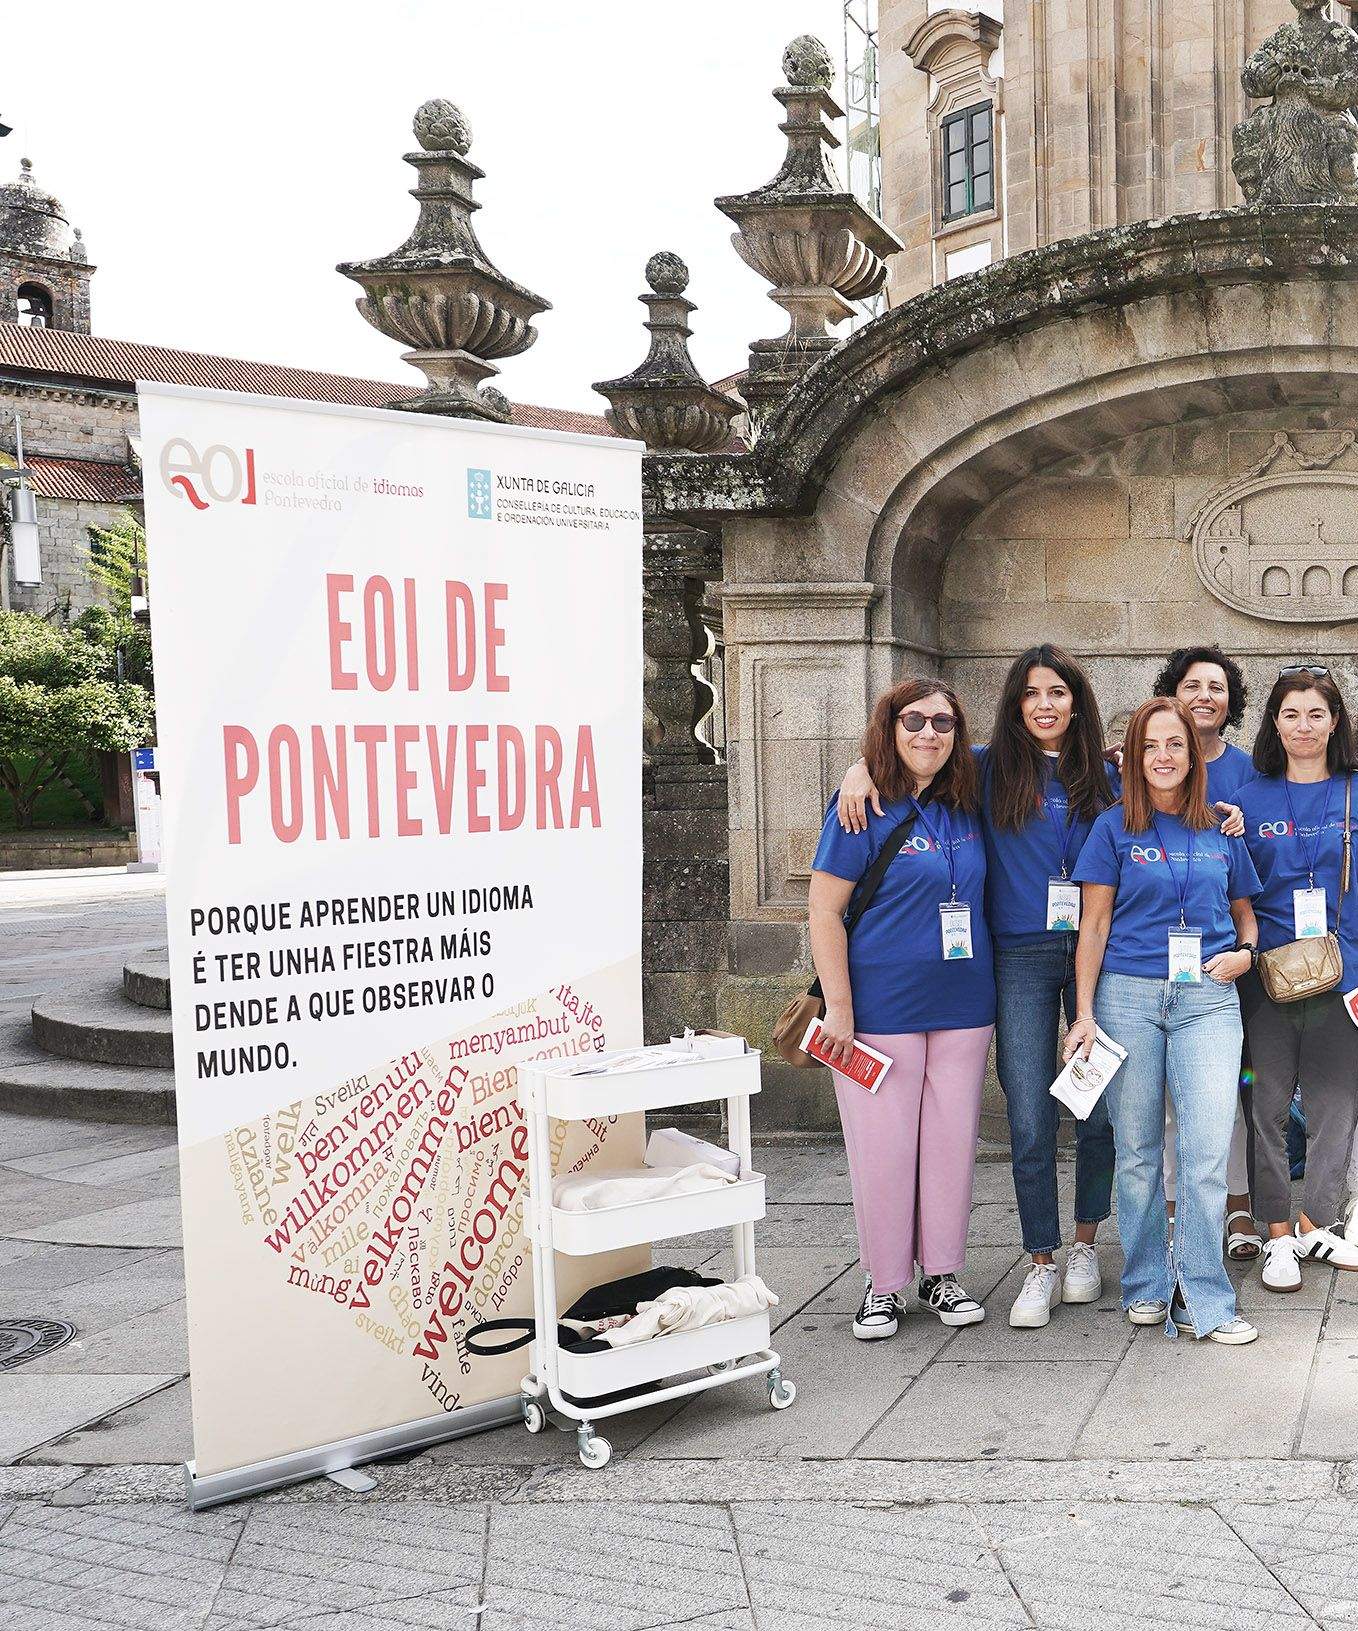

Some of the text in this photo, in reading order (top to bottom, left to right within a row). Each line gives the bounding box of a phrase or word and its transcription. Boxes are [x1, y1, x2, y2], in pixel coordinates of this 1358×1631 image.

[262, 470, 425, 498] escola oficial de idiomas
[263, 489, 343, 512] Pontevedra
[496, 474, 596, 498] XUNTA DE GALICIA
[551, 503, 561, 514] DE
[556, 518, 610, 531] UNIVERSITARIA
[326, 572, 511, 693] EOI DE
[222, 723, 602, 845] PONTEVEDRA
[190, 884, 534, 937] PORQUE APRENDER UN IDIOMA
[193, 927, 491, 985] É TER UNHA FIESTRA MÁIS
[195, 996, 279, 1032] DENDE
[286, 994, 302, 1022] A
[308, 988, 355, 1022] QUE
[362, 975, 475, 1014] OBSERVAR
[481, 972, 494, 998] O
[197, 1041, 297, 1079] MUNDO.
[448, 1011, 571, 1060] menyambut
[294, 1050, 424, 1179] benvenuti
[263, 1078, 433, 1257] willkommen
[348, 1064, 470, 1310] velkommen
[372, 1109, 430, 1219] пожаловать
[457, 1150, 485, 1234] просимо
[291, 1161, 389, 1264] välkomna
[321, 1221, 370, 1268] mile
[407, 1225, 423, 1310] ласкаво
[412, 1125, 530, 1361] welcome
[490, 1254, 524, 1312] Добро
